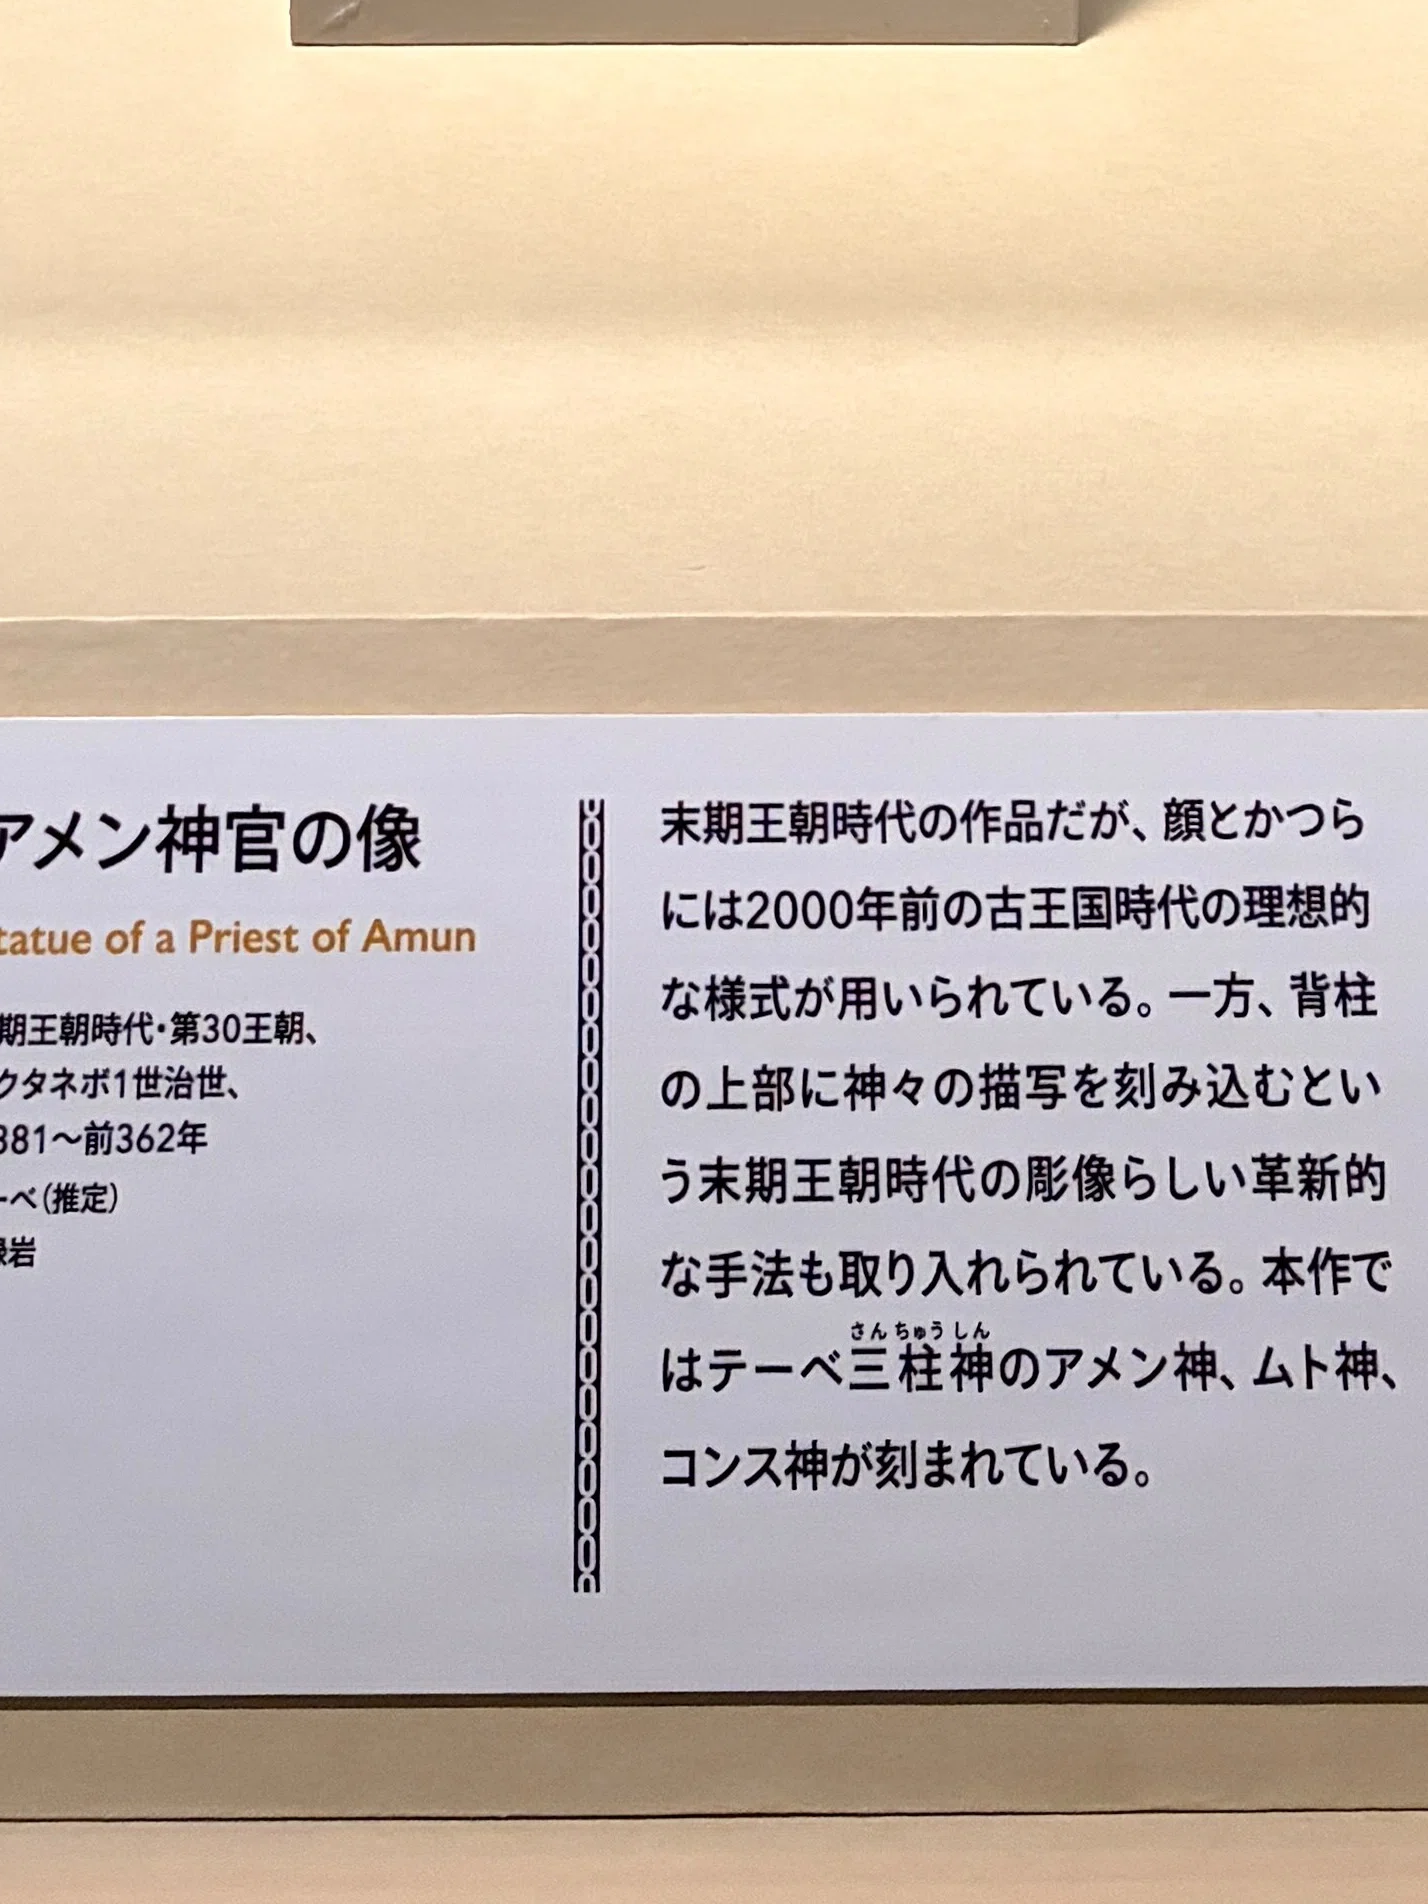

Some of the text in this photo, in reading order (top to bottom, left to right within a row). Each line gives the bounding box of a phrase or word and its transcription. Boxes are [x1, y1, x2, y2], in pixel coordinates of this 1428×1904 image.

[662, 881, 1370, 933] には2000年前の古王国時代の理想的
[104, 919, 147, 956] of
[155, 928, 176, 955] a
[189, 918, 300, 955] Priest
[311, 917, 353, 954] of
[360, 918, 477, 953] Amun
[660, 1060, 1382, 1113] の上部に神々の描写を刻み込むとい
[661, 1151, 1386, 1205] う末期王朝時代の彫像らしい革新的
